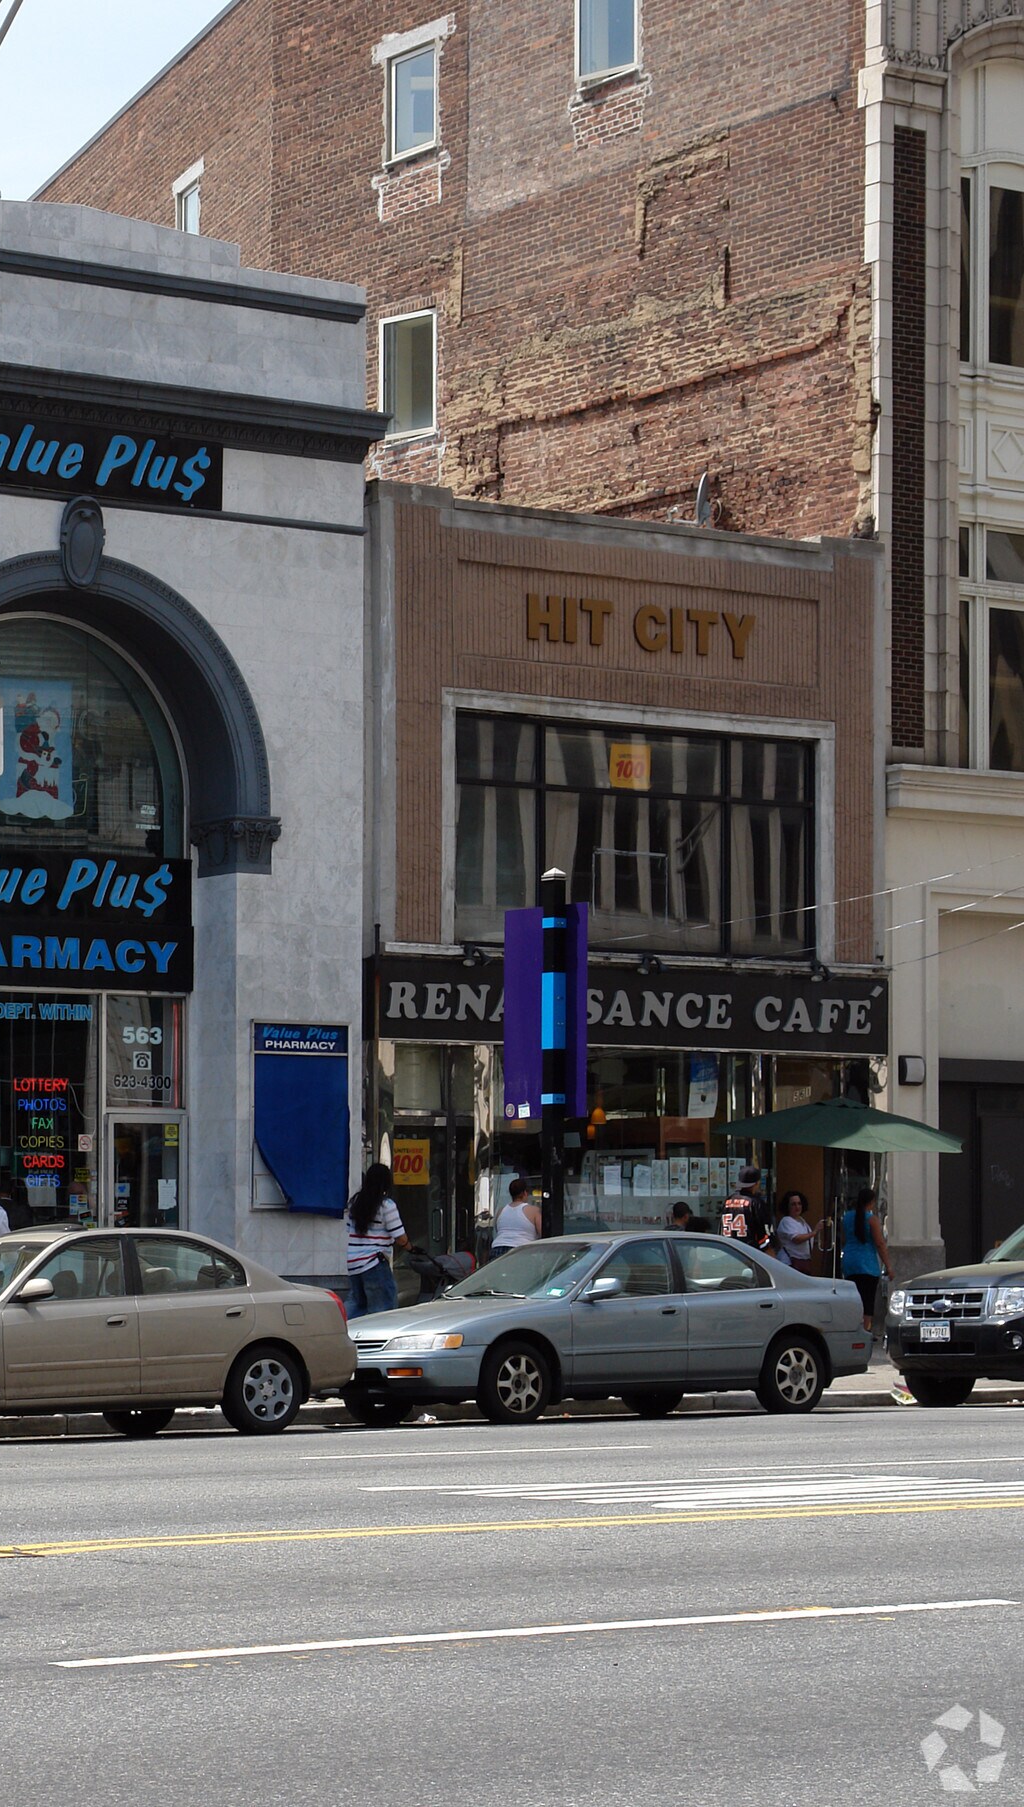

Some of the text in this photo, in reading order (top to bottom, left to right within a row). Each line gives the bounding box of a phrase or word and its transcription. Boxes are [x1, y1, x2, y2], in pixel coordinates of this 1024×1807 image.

[95, 434, 211, 501] Plu$
[527, 593, 757, 659] HIT CITY
[615, 759, 645, 779] 100
[56, 857, 174, 918] Plu$
[38, 1004, 94, 1021] WITHIN
[386, 981, 884, 1035] RENSANCE CAFÉ
[122, 1026, 164, 1046] 563
[262, 1026, 339, 1040] Value Plus
[264, 1039, 336, 1050] PHARMACY
[13, 1077, 69, 1092] LOTTERY
[17, 1097, 67, 1112] PHOTOS
[31, 1116, 55, 1130] FAX
[20, 1135, 65, 1149] COPIES
[22, 1155, 66, 1169] CARDS
[393, 1154, 424, 1174] 100
[25, 1174, 62, 1188] GIFTS
[721, 1213, 748, 1238] 54
